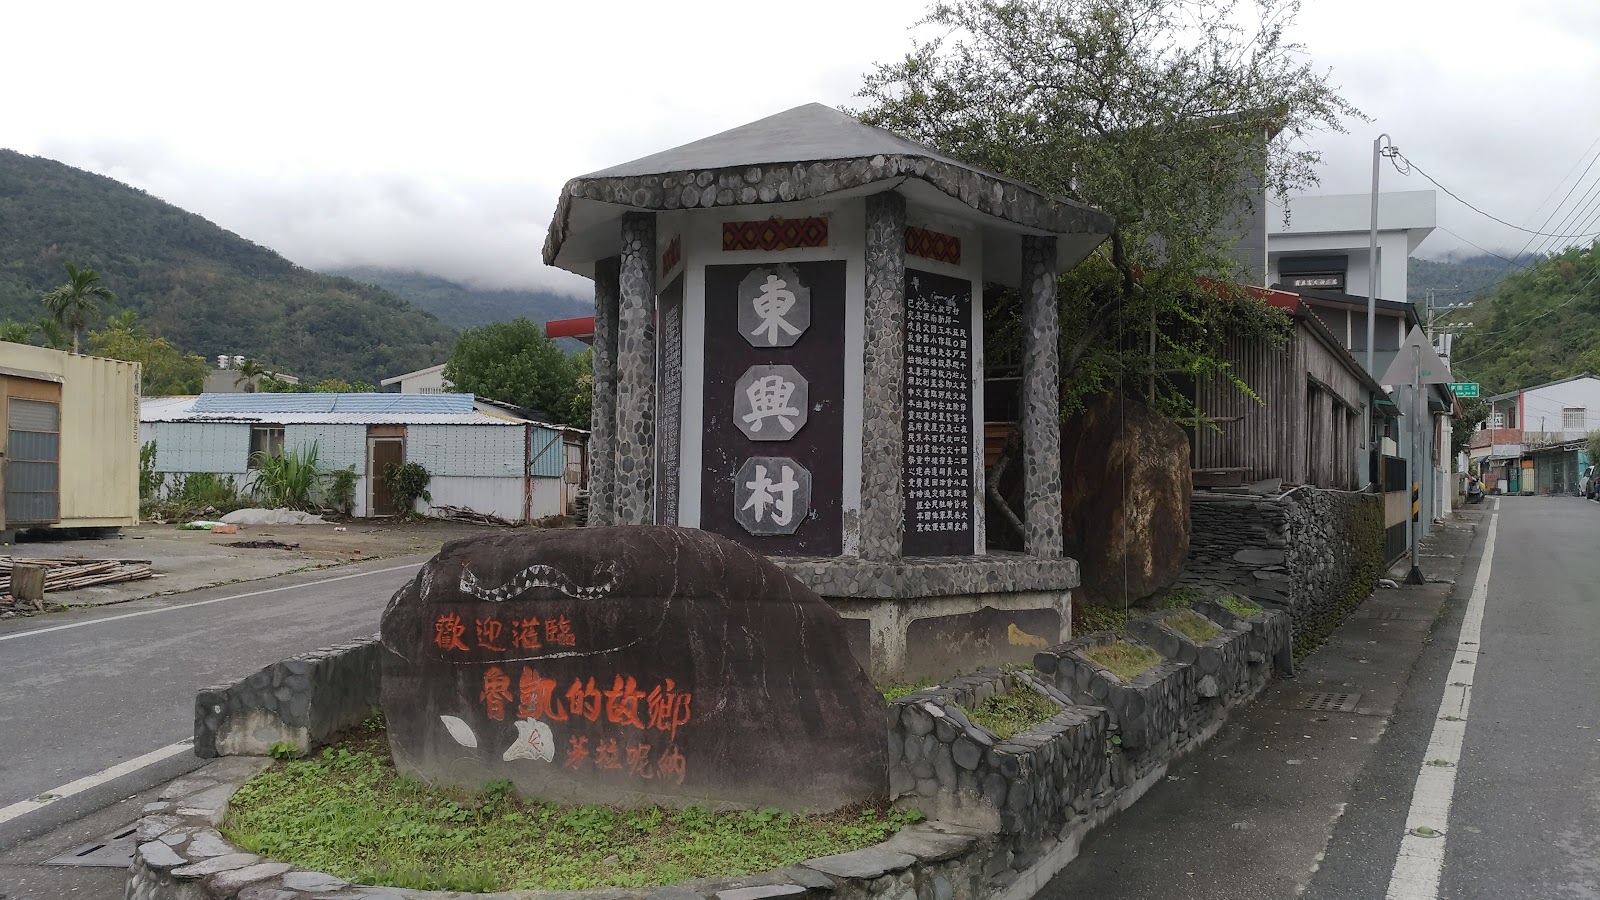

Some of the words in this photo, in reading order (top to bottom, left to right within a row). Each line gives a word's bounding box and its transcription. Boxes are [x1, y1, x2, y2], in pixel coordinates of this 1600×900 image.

[742, 275, 801, 527] 東興村
[480, 666, 691, 741] 魯凱的故鄉
